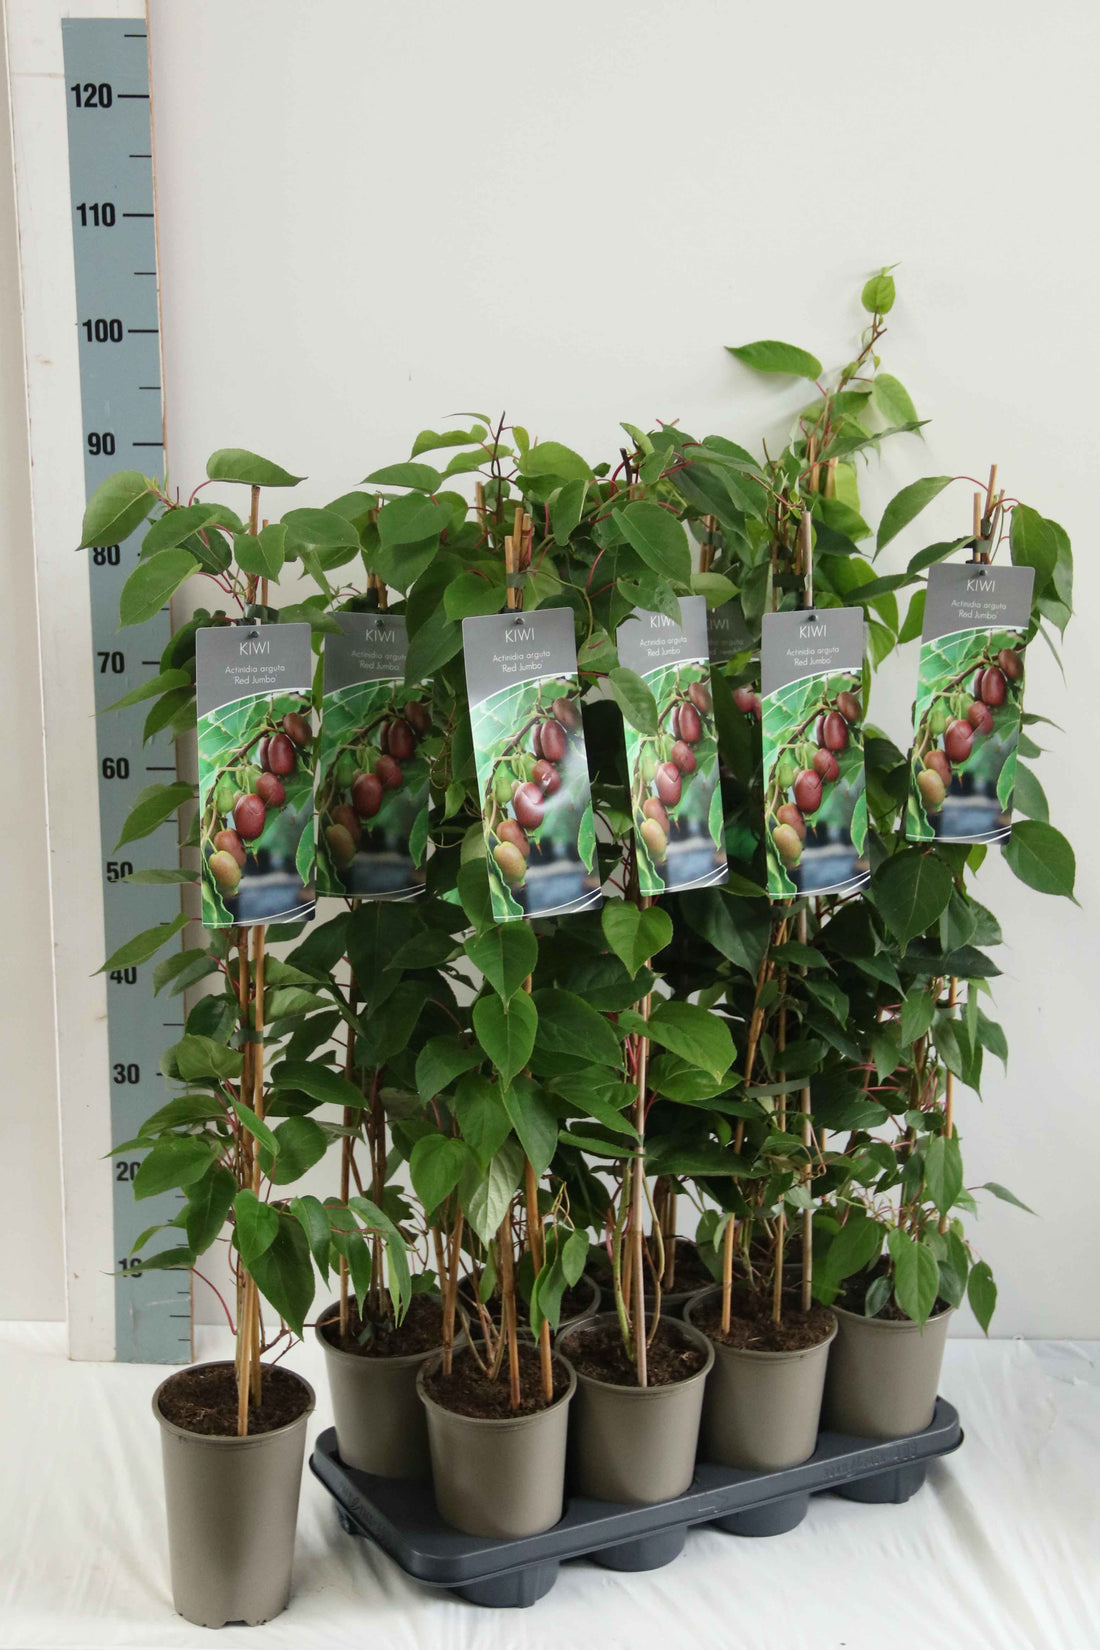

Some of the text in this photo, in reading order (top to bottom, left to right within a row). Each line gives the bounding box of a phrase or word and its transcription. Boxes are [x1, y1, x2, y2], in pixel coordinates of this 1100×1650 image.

[70, 82, 113, 109] 120
[76, 202, 116, 227] 110
[82, 318, 123, 343] 100
[87, 432, 116, 456] 90
[93, 543, 120, 566] 80
[966, 578, 996, 593] KIWI
[951, 599, 1007, 611] Actinidia arguta
[709, 619, 729, 630] IWI
[799, 624, 827, 639] KIWI
[365, 628, 395, 643] KIWI
[505, 627, 535, 643] KIWI
[640, 636, 688, 648] Actinidia arguta
[239, 640, 270, 656] KIWI
[786, 647, 840, 657] Actinidia arguta
[97, 651, 126, 674] 70
[492, 650, 551, 663] Actinidia arguta
[225, 664, 286, 674] Actinidia arguta
[101, 757, 130, 780] 60
[106, 861, 134, 883] 50
[110, 966, 137, 985] 40
[113, 1063, 140, 1085] 30
